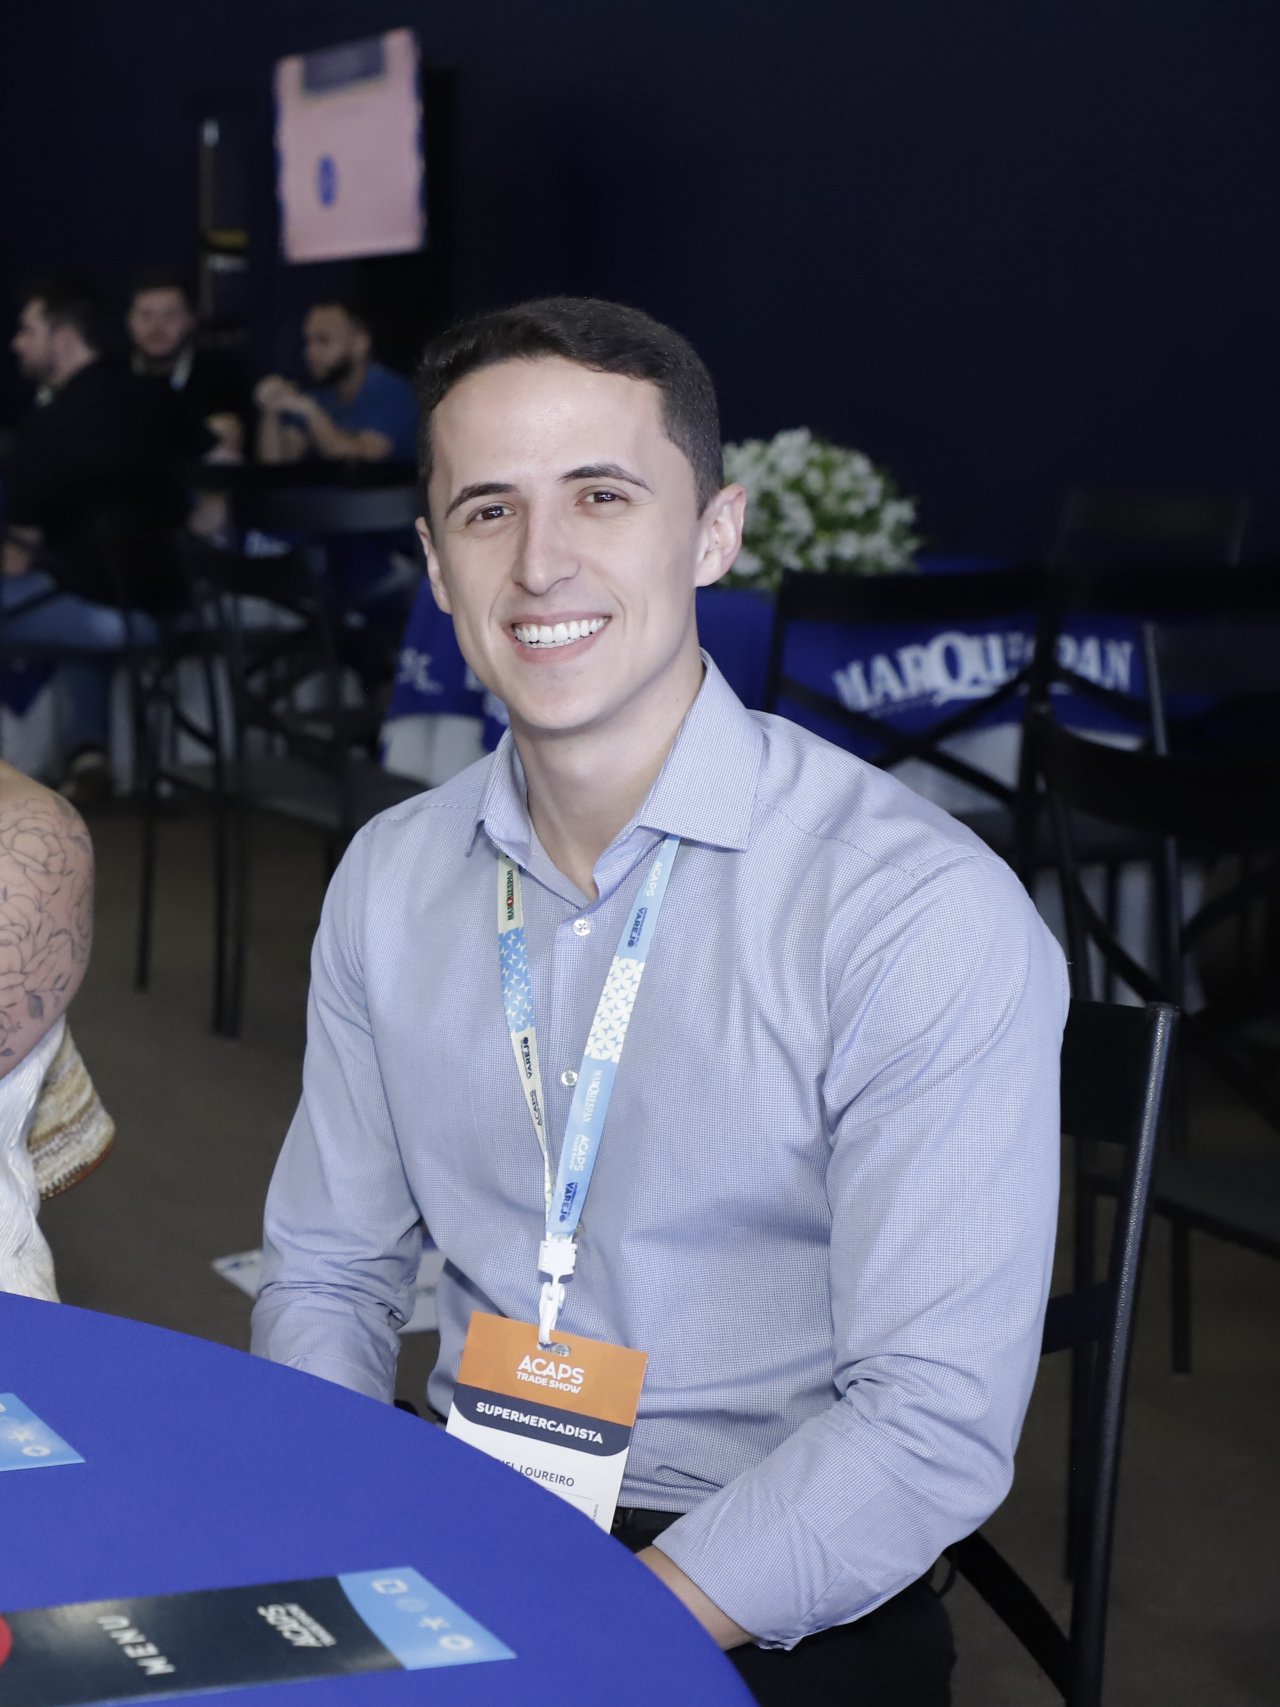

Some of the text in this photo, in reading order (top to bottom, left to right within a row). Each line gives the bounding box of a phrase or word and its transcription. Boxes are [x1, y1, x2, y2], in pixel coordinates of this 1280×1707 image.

[627, 907, 646, 948] VAREJO
[521, 1036, 533, 1080] VAREJO
[574, 1134, 591, 1172] ACAPS
[558, 1182, 575, 1223] VAREJO
[516, 1371, 581, 1394] TRADE SHOW
[517, 1354, 585, 1385] ACAPS
[476, 1401, 603, 1444] SUPERMERCADISTA
[519, 1464, 575, 1487] LOUREIRO
[97, 1615, 175, 1675] MENU
